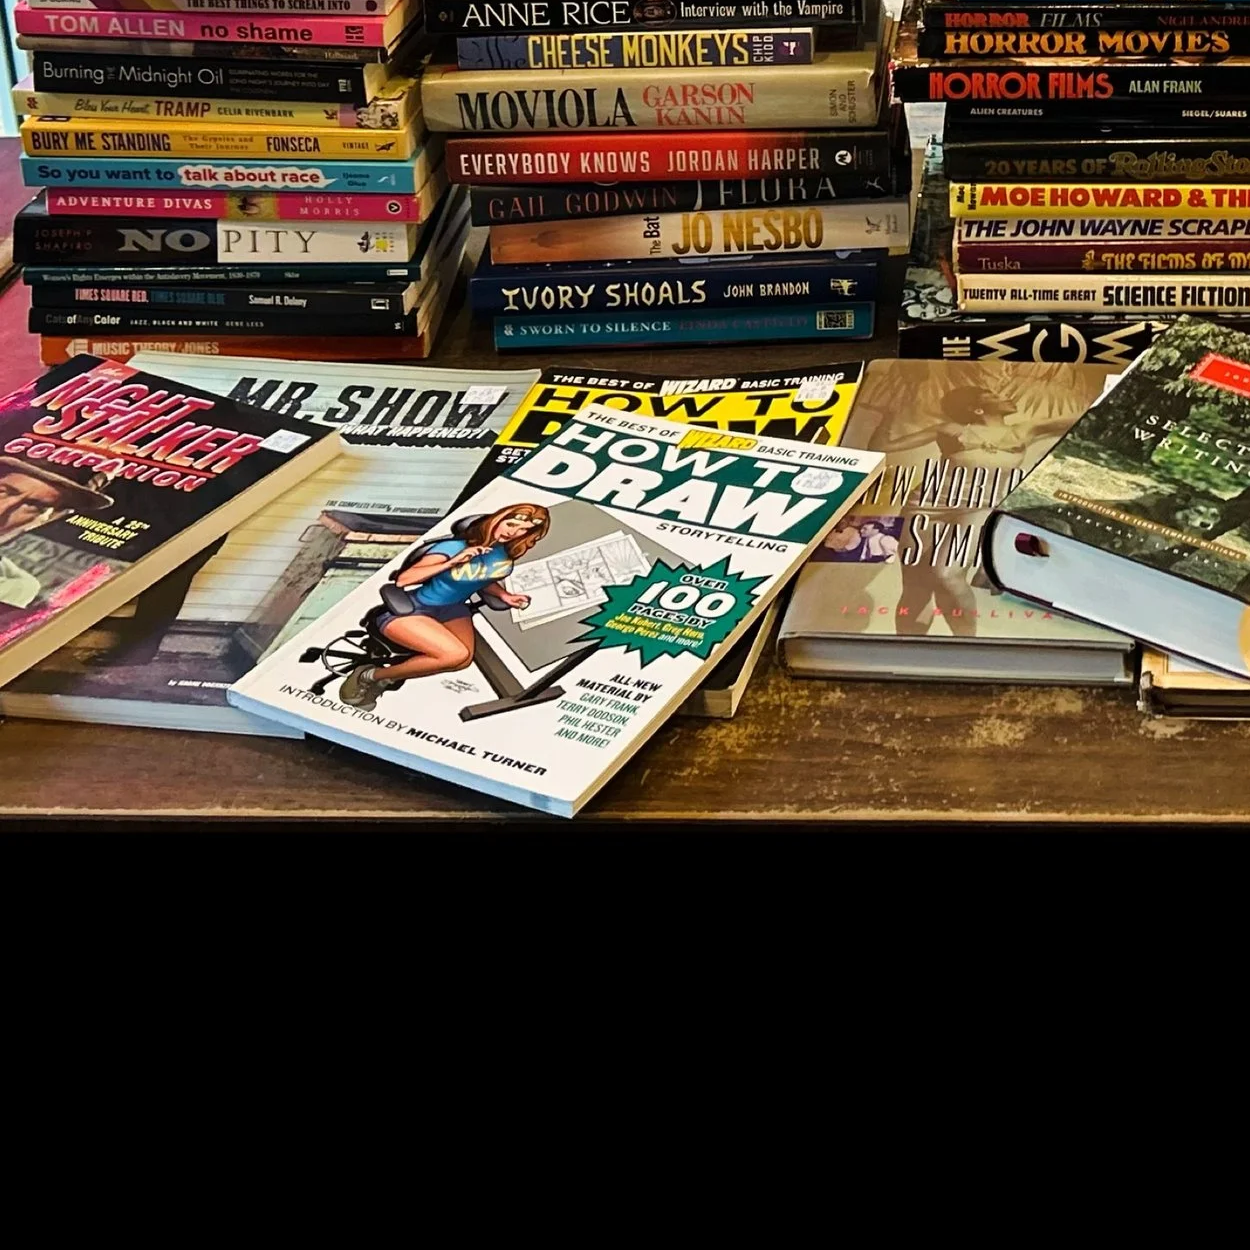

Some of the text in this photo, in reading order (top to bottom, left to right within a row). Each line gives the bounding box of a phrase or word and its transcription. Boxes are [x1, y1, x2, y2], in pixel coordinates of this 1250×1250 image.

[44, 15, 184, 36] TOM ALLEN
[201, 23, 312, 40] no shame
[527, 33, 749, 68] CHEESE MONKEYS
[930, 73, 1113, 99] HORROR FILMS
[1129, 79, 1202, 93] ALAN FRANK
[456, 86, 637, 130] MOVIOLA
[32, 132, 171, 151] BURY ME STANDING
[267, 137, 320, 152] FONSECA
[460, 151, 650, 175] EVERYBODY KNOWS
[668, 148, 820, 172] JORDAN HARPER
[39, 166, 320, 184] So you want to talk about race
[980, 188, 1052, 208] MOE
[1056, 189, 1182, 208] HOWARD
[1189, 190, 1208, 208] &
[117, 229, 209, 252] NO
[223, 230, 318, 252] PITY
[502, 280, 707, 311] IVORY SHOALS
[1103, 284, 1177, 306] SCIENCE
[659, 378, 736, 396] WIZARD
[4, 437, 207, 492] COMPANION
[554, 424, 844, 495] HOW TO
[758, 446, 859, 466] BASIC TRAINING
[512, 444, 827, 537] DRAW
[656, 522, 788, 553] STORYTELLING
[681, 574, 727, 590] OVER
[639, 581, 736, 617] 100
[405, 727, 547, 776] MICHAEL TURNER
